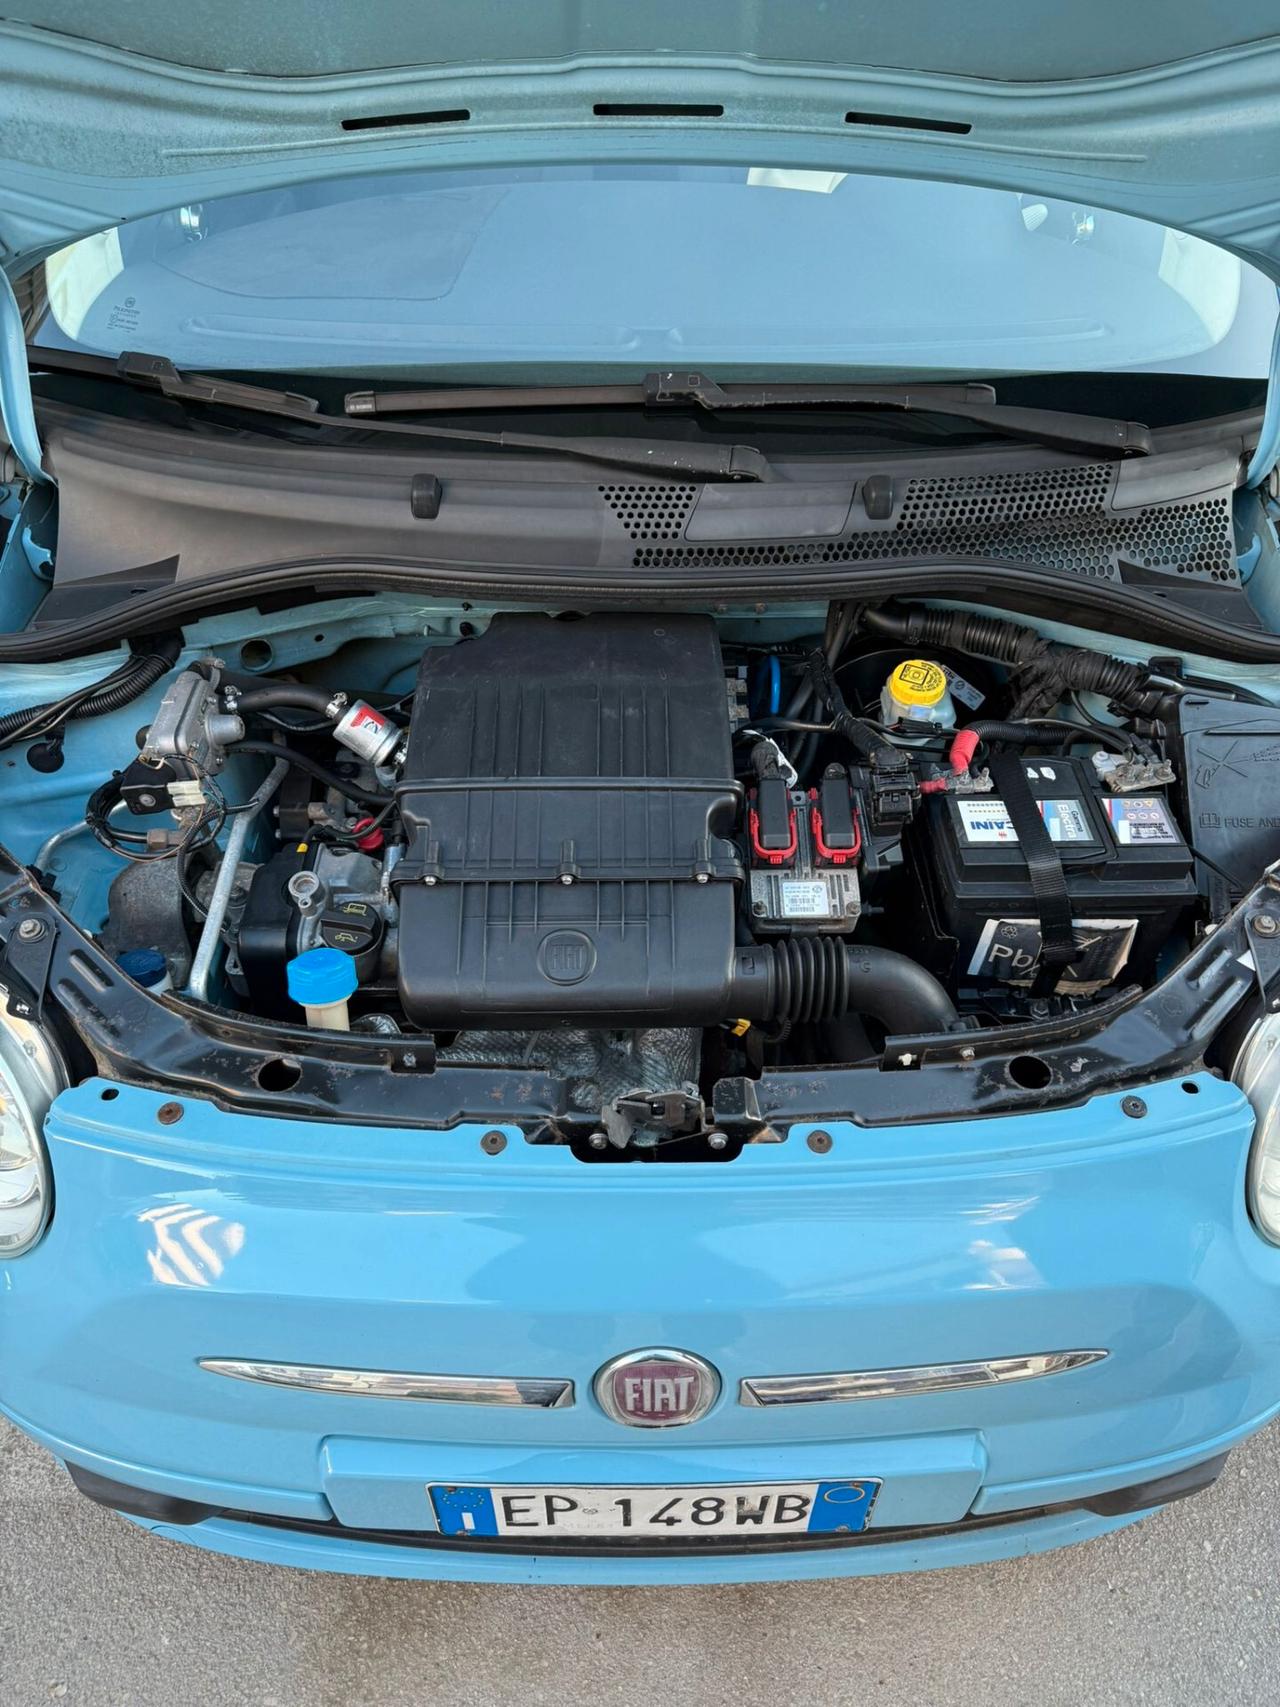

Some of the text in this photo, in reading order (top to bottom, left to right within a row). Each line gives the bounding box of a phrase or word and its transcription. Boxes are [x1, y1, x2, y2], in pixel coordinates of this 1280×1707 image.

[1225, 817, 1255, 828] FUSE
[988, 943, 1034, 967] Pb
[625, 1376, 694, 1412] FIAT
